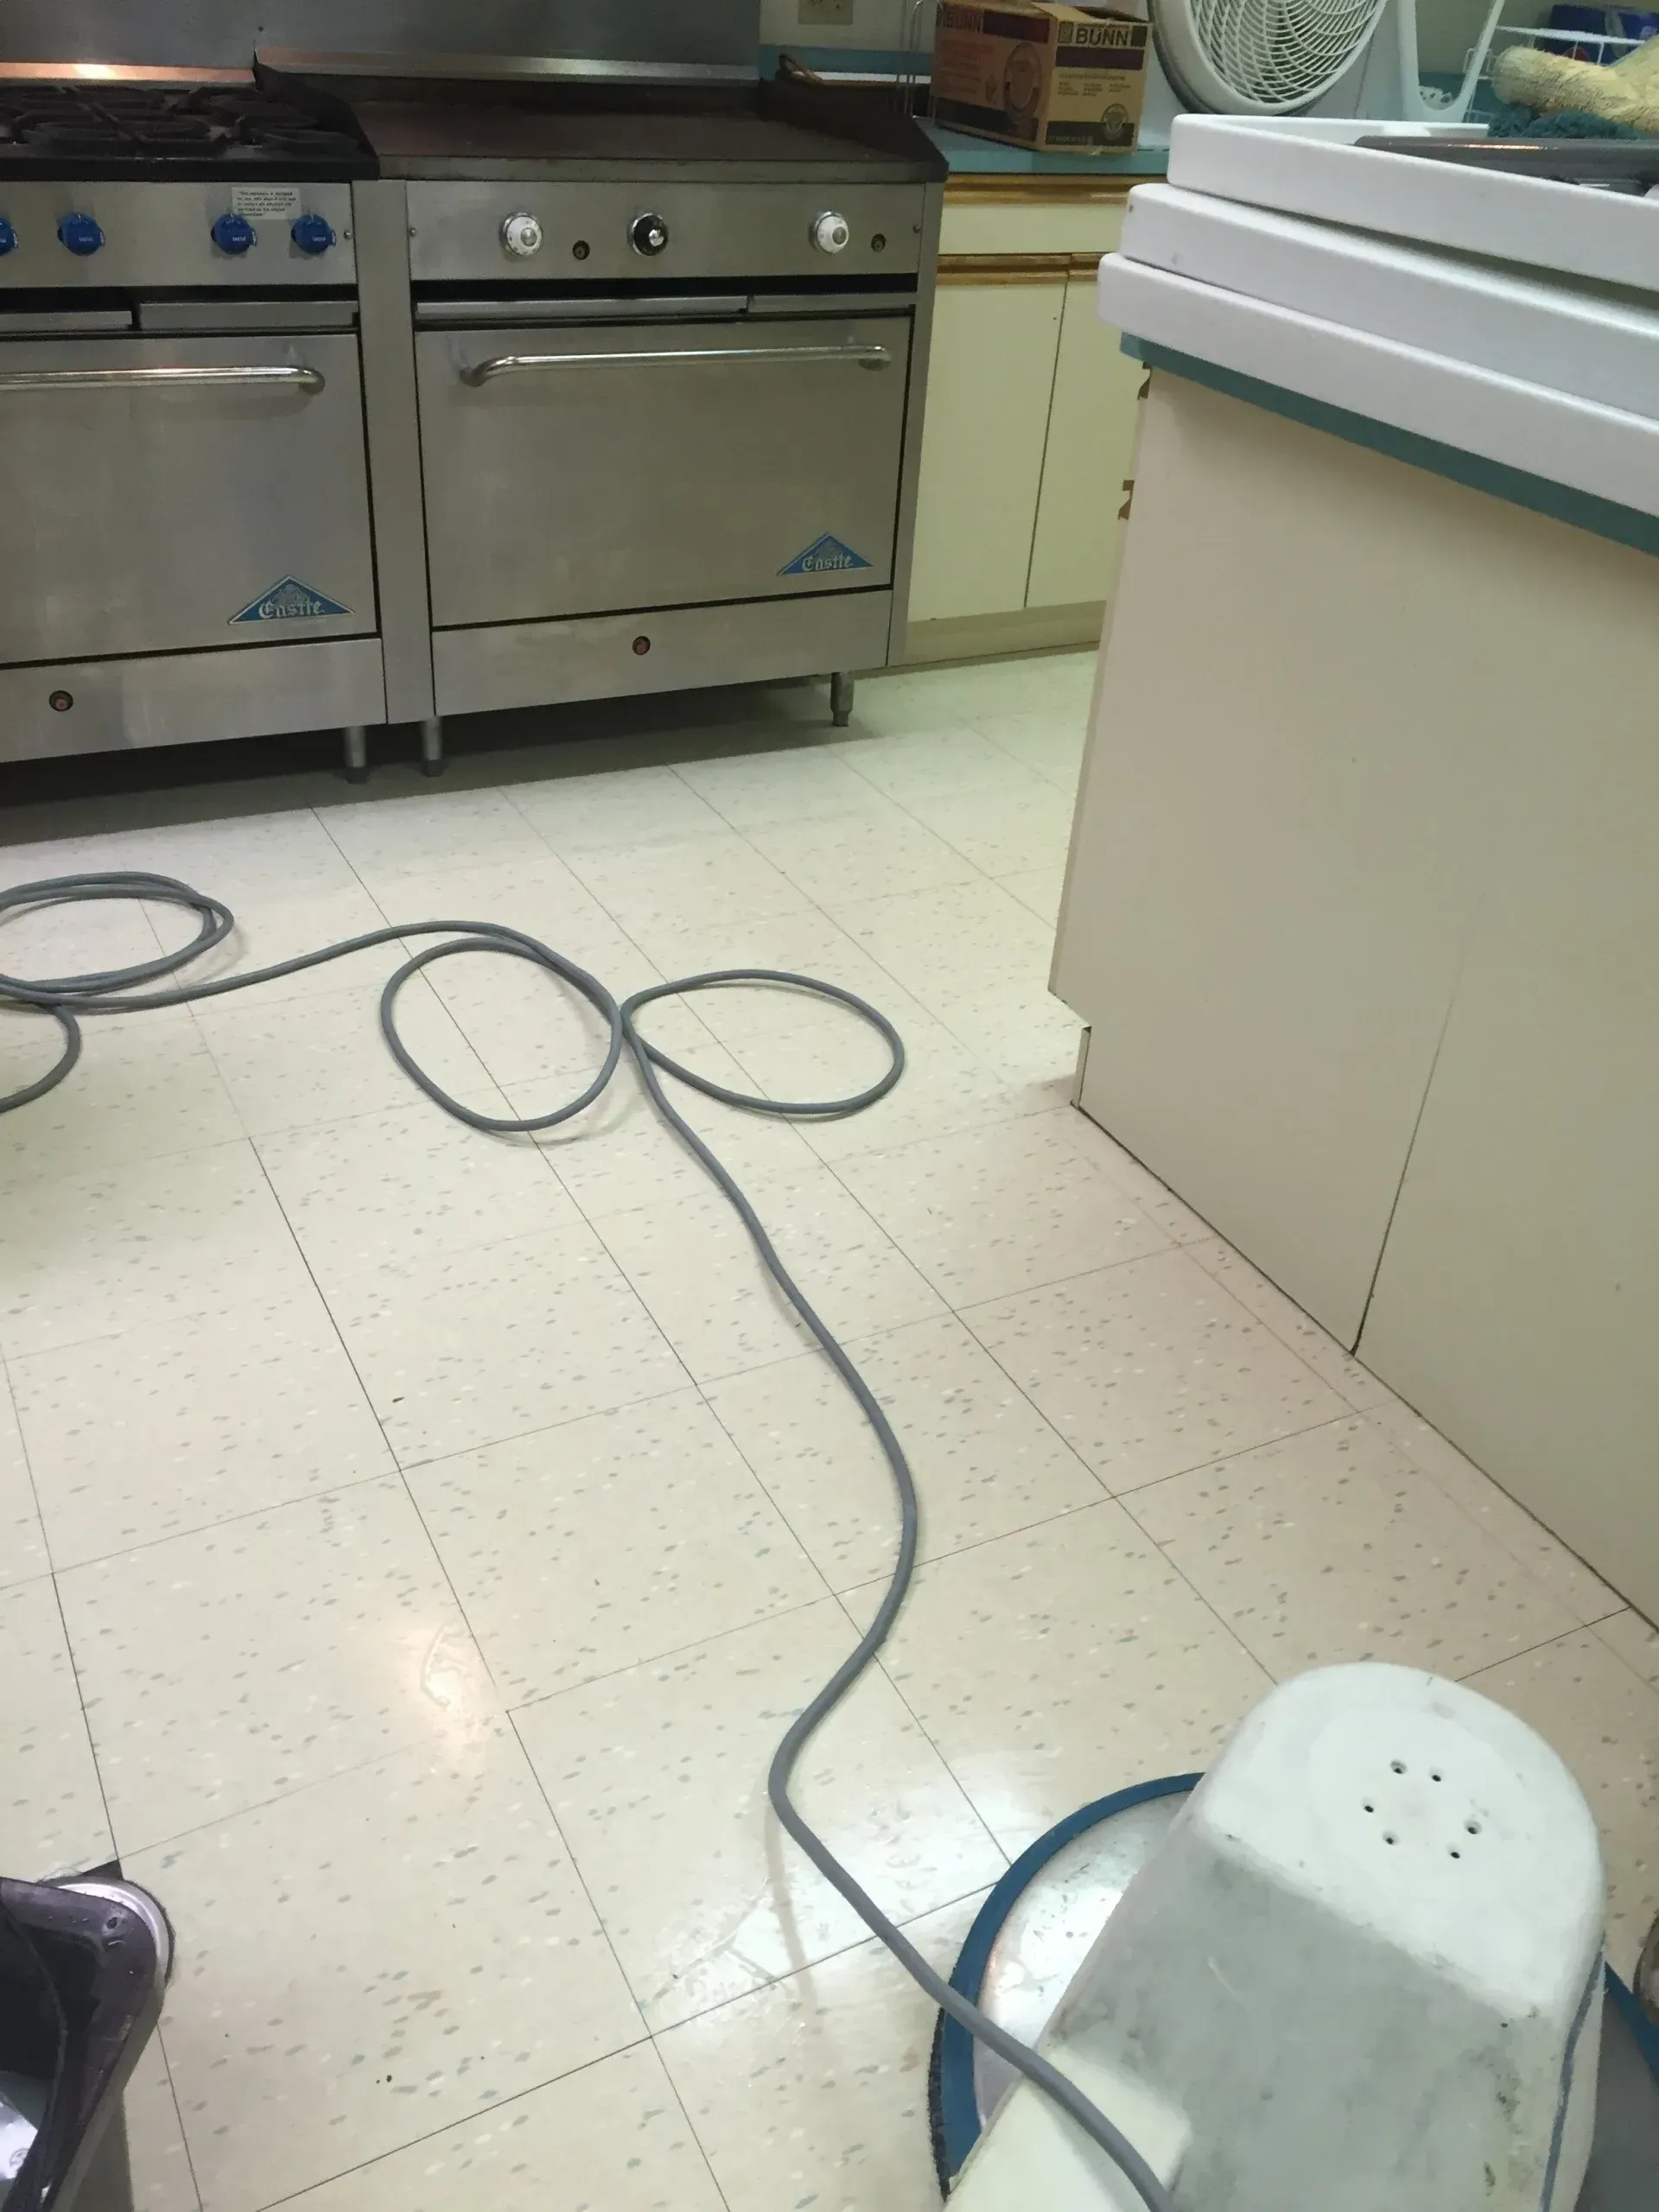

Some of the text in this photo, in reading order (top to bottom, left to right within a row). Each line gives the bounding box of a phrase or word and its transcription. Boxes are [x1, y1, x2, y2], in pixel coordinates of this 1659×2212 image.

[1076, 27, 1129, 46] BUNN
[802, 553, 854, 571] Castle
[258, 597, 325, 619] Castle
